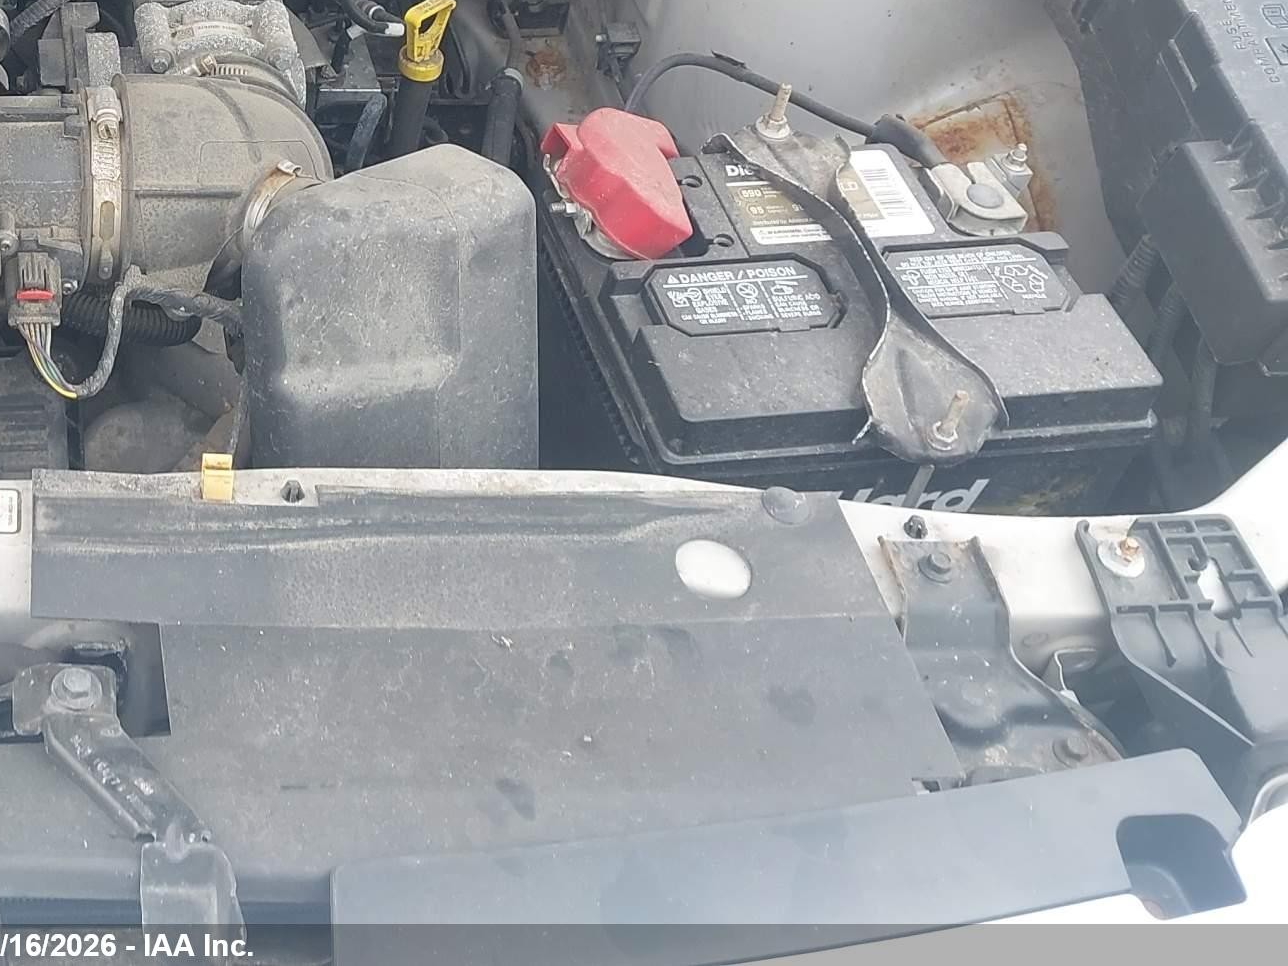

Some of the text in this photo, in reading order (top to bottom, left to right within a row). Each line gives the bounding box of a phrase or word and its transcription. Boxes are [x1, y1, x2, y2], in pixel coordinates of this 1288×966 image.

[1222, 20, 1246, 50] FUSE
[679, 266, 797, 284] DANGER / POISON
